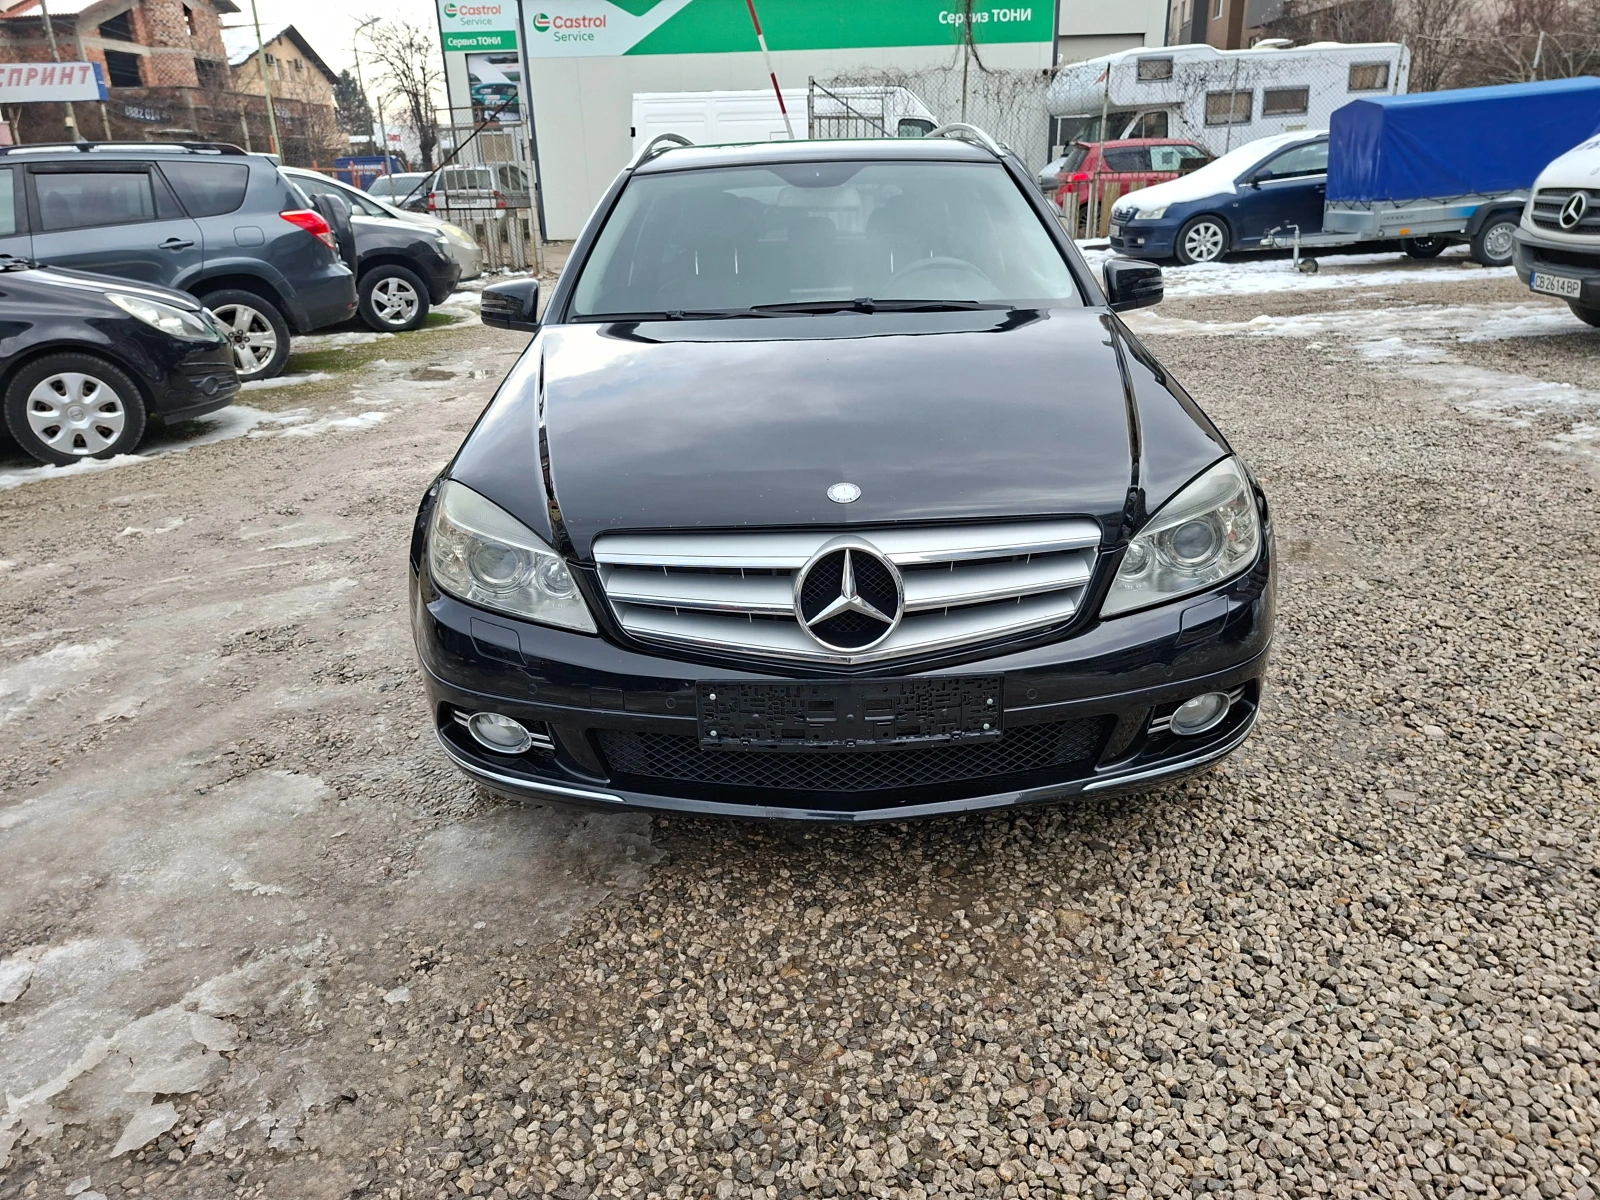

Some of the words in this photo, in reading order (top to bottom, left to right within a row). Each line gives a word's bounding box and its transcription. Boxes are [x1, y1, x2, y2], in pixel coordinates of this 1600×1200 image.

[459, 5, 502, 15] Castrol
[460, 17, 492, 26] Service
[553, 15, 606, 29] Castrol
[938, 11, 989, 27] Сериз
[991, 8, 1032, 22] ТОНИ
[447, 37, 477, 48] Сервиз
[477, 36, 501, 46] ТОНИ
[553, 31, 594, 42] Service
